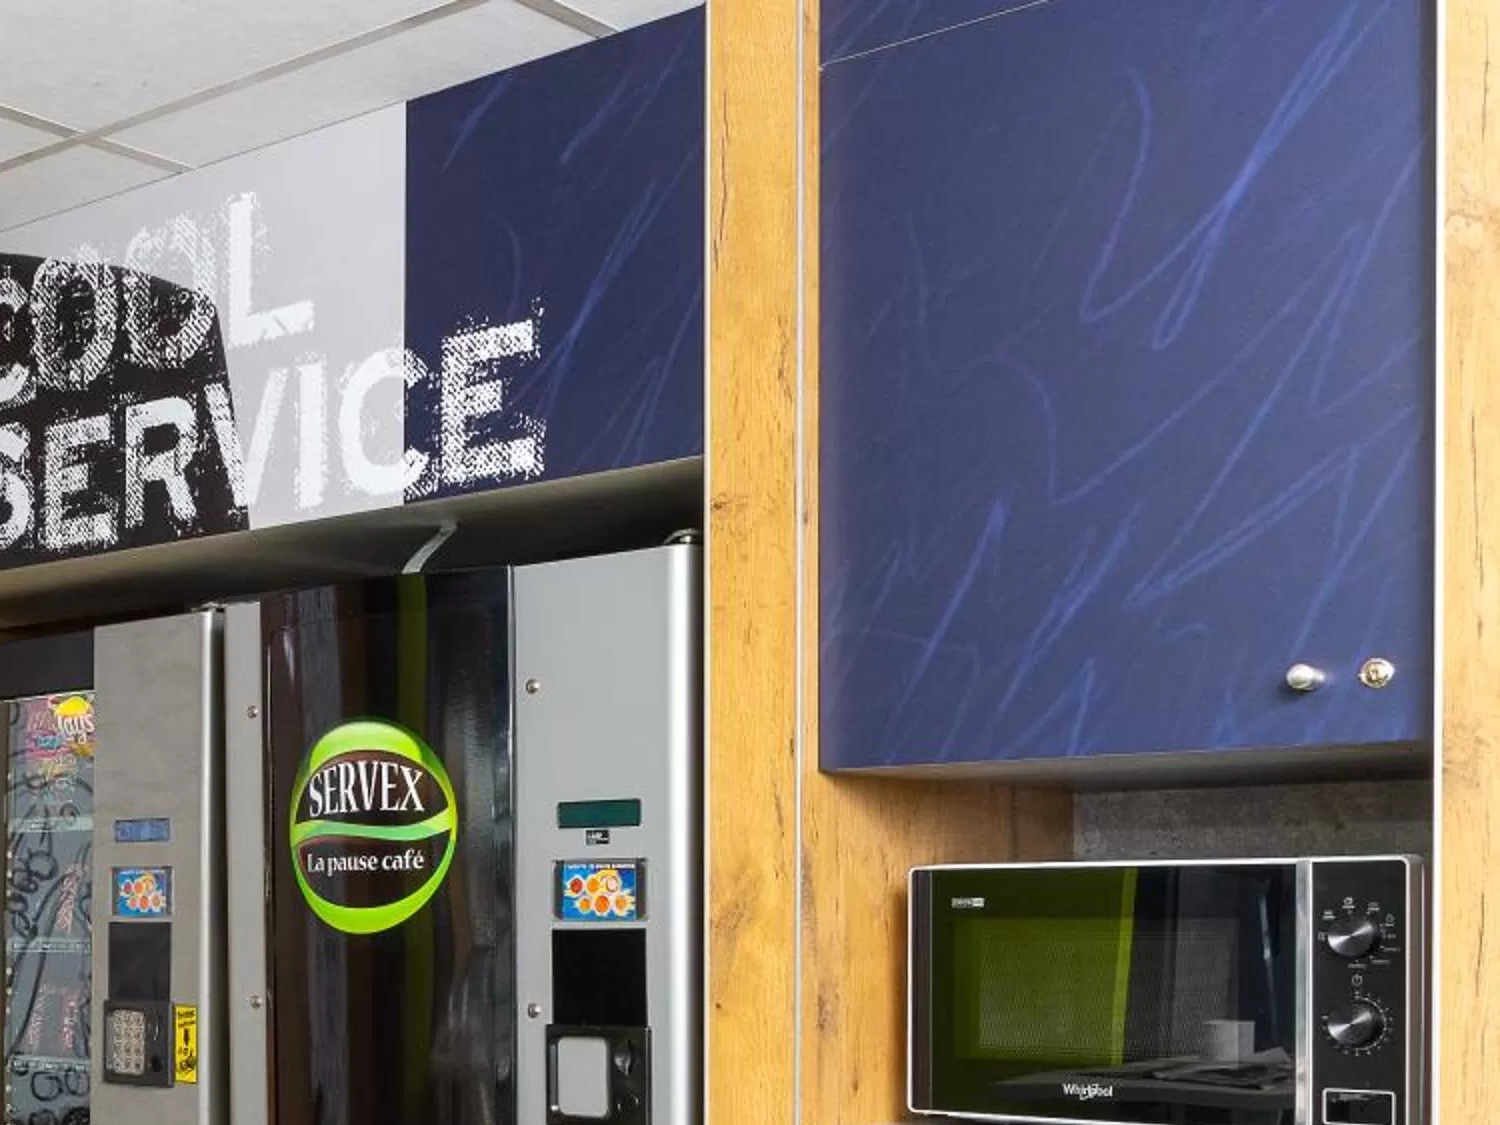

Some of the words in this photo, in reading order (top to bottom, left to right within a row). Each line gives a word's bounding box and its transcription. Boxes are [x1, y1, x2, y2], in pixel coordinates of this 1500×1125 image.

[309, 760, 425, 817] SERVEX
[307, 853, 325, 873] La
[327, 853, 378, 877] pause
[381, 848, 425, 871] café
[1061, 1083, 1114, 1101] Whirlpool
